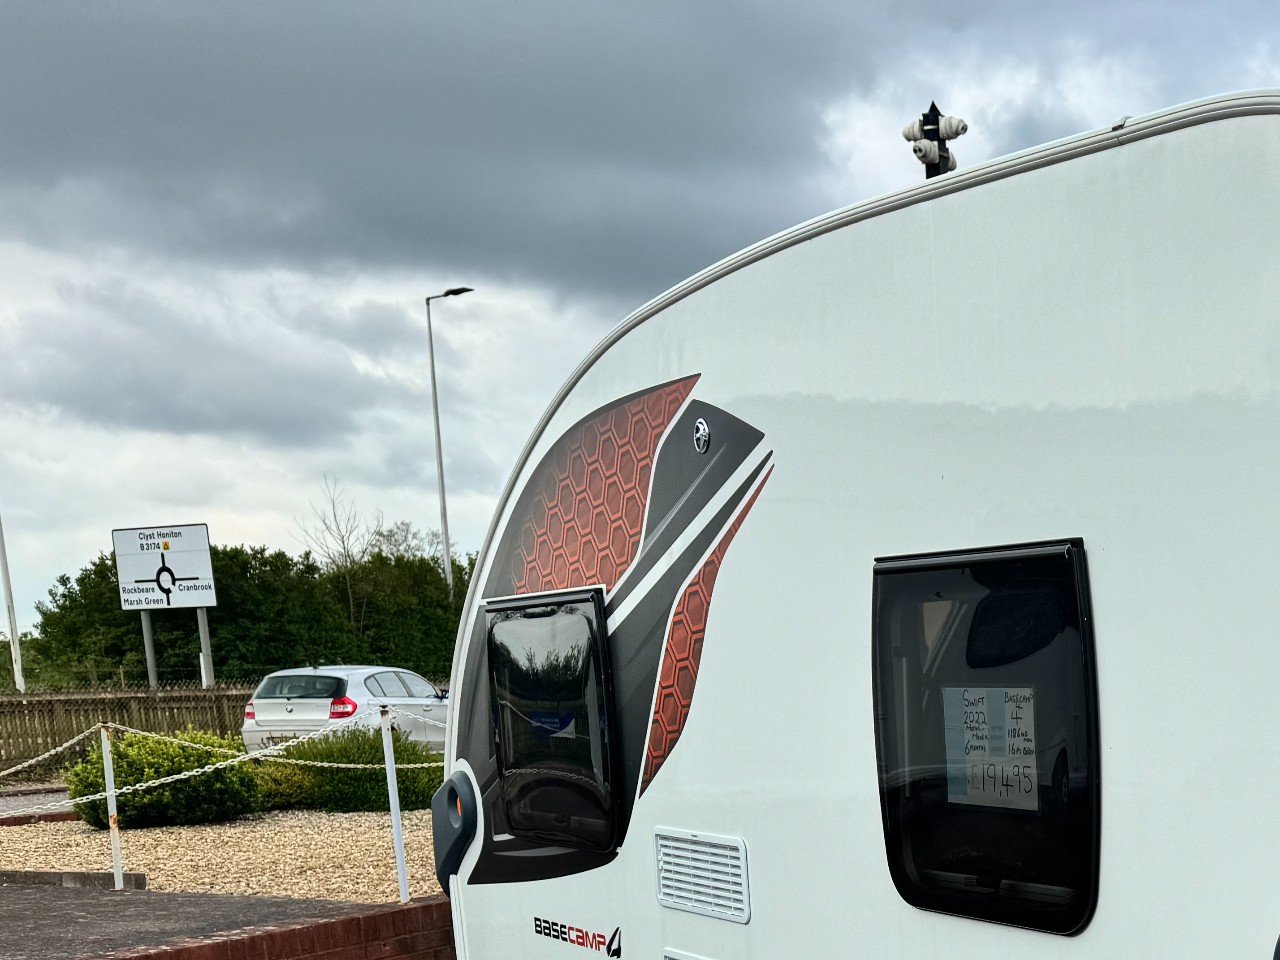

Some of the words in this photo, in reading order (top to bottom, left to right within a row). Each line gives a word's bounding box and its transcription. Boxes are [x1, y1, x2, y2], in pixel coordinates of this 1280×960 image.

[138, 532, 155, 541] Clyst
[157, 531, 182, 539] Honiton
[146, 543, 160, 551] 3174
[178, 584, 212, 592] Cranbrook
[124, 598, 142, 606] Marsh
[144, 597, 164, 605] Green
[964, 711, 987, 725] 2022
[1011, 710, 1023, 726] 4
